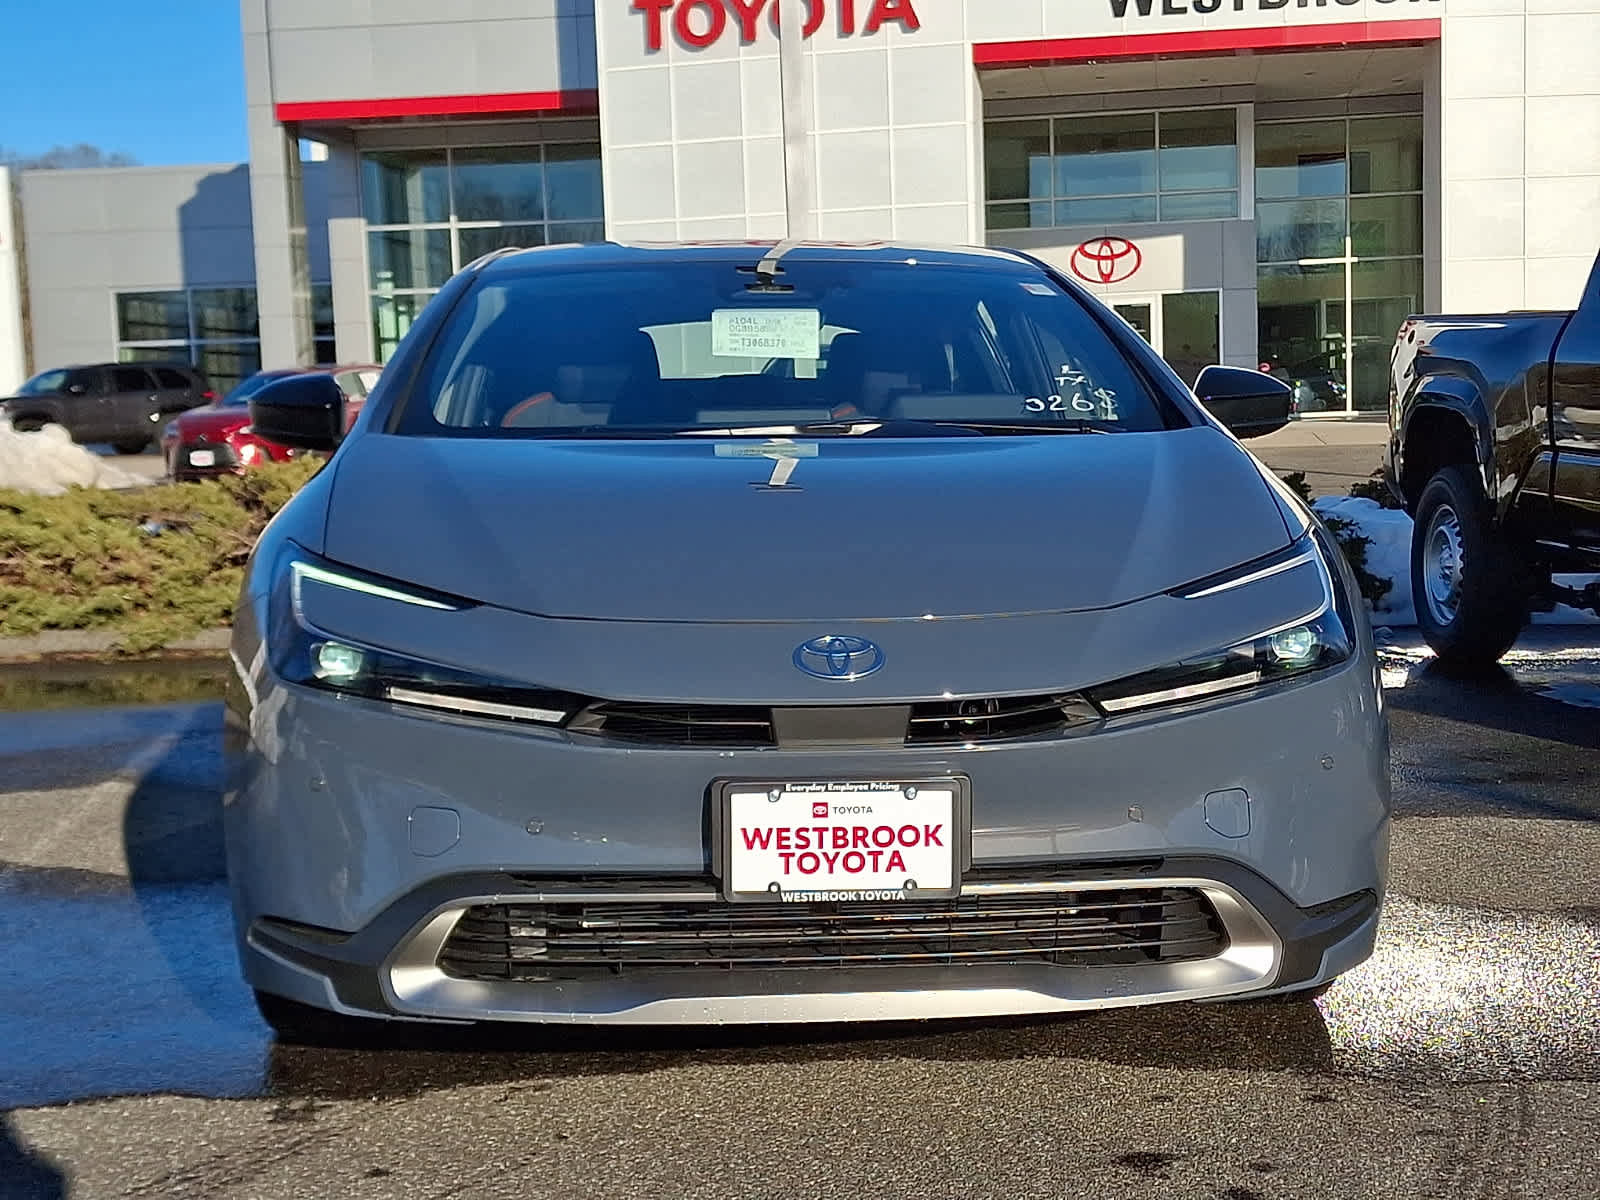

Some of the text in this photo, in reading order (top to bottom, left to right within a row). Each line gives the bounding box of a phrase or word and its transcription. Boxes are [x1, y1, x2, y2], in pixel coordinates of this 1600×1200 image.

[785, 782, 900, 792] Everyday Employee Pricing
[832, 806, 873, 815] TOYOTA
[740, 824, 944, 850] WESTBROOK
[778, 850, 907, 875] TOYOTA
[781, 890, 906, 903] WESTBROOK TOYOTA
